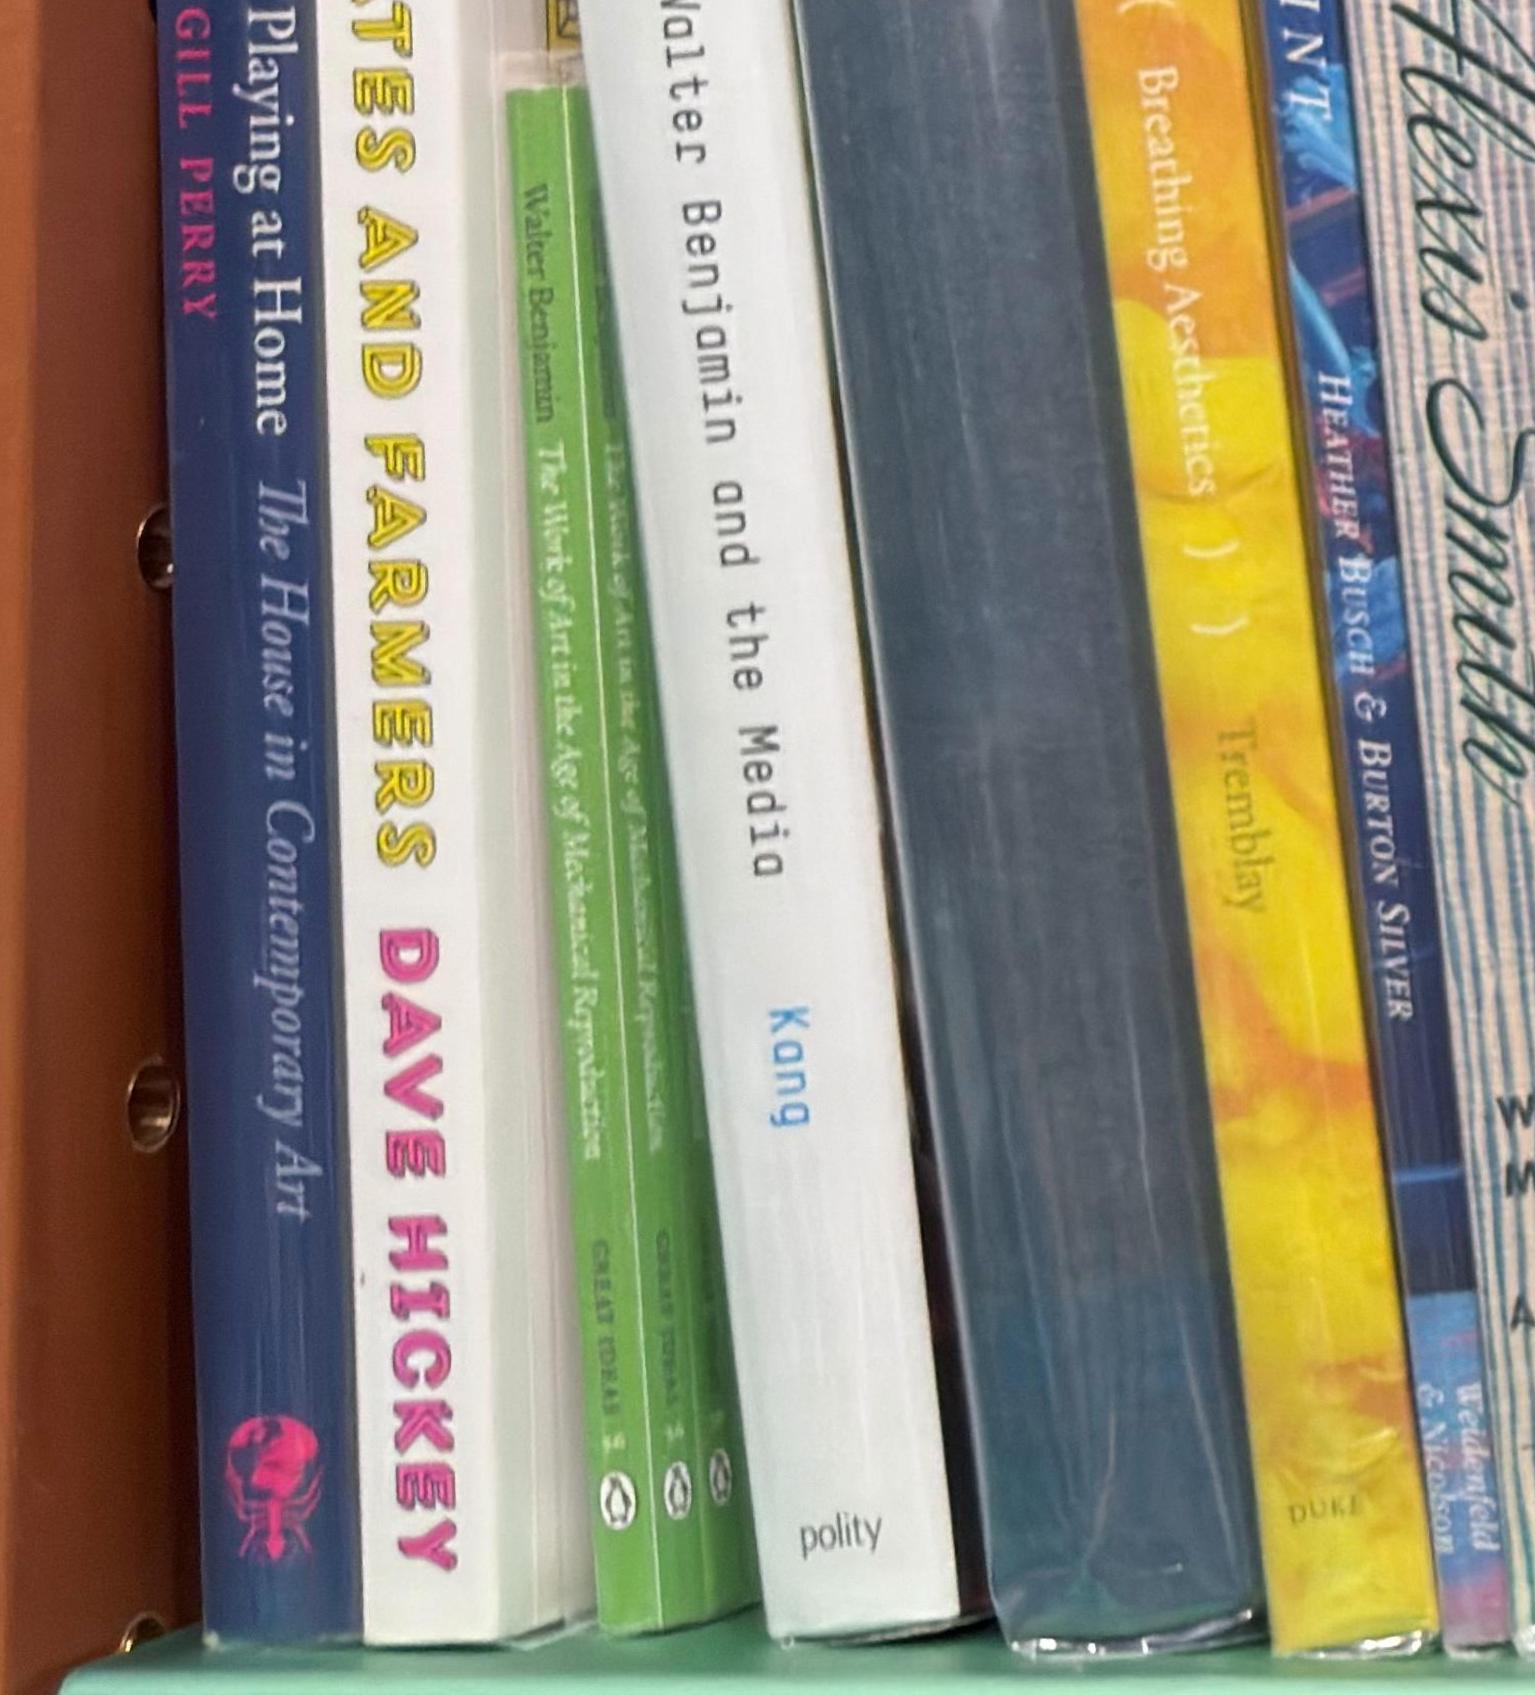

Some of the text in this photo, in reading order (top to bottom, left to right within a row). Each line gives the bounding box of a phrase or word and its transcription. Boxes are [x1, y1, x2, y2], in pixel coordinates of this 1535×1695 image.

[681, 197, 742, 446] Benjamin
[1134, 65, 1216, 499] Breathing Aesthetics
[712, 480, 758, 568] and
[233, 4, 323, 1221] Playing at Home The House in Contemporary Art
[724, 599, 763, 693] the
[738, 723, 785, 879] Media
[1216, 726, 1275, 916] Tremblay
[767, 1006, 811, 1129] Kang
[799, 1513, 883, 1557] polity
